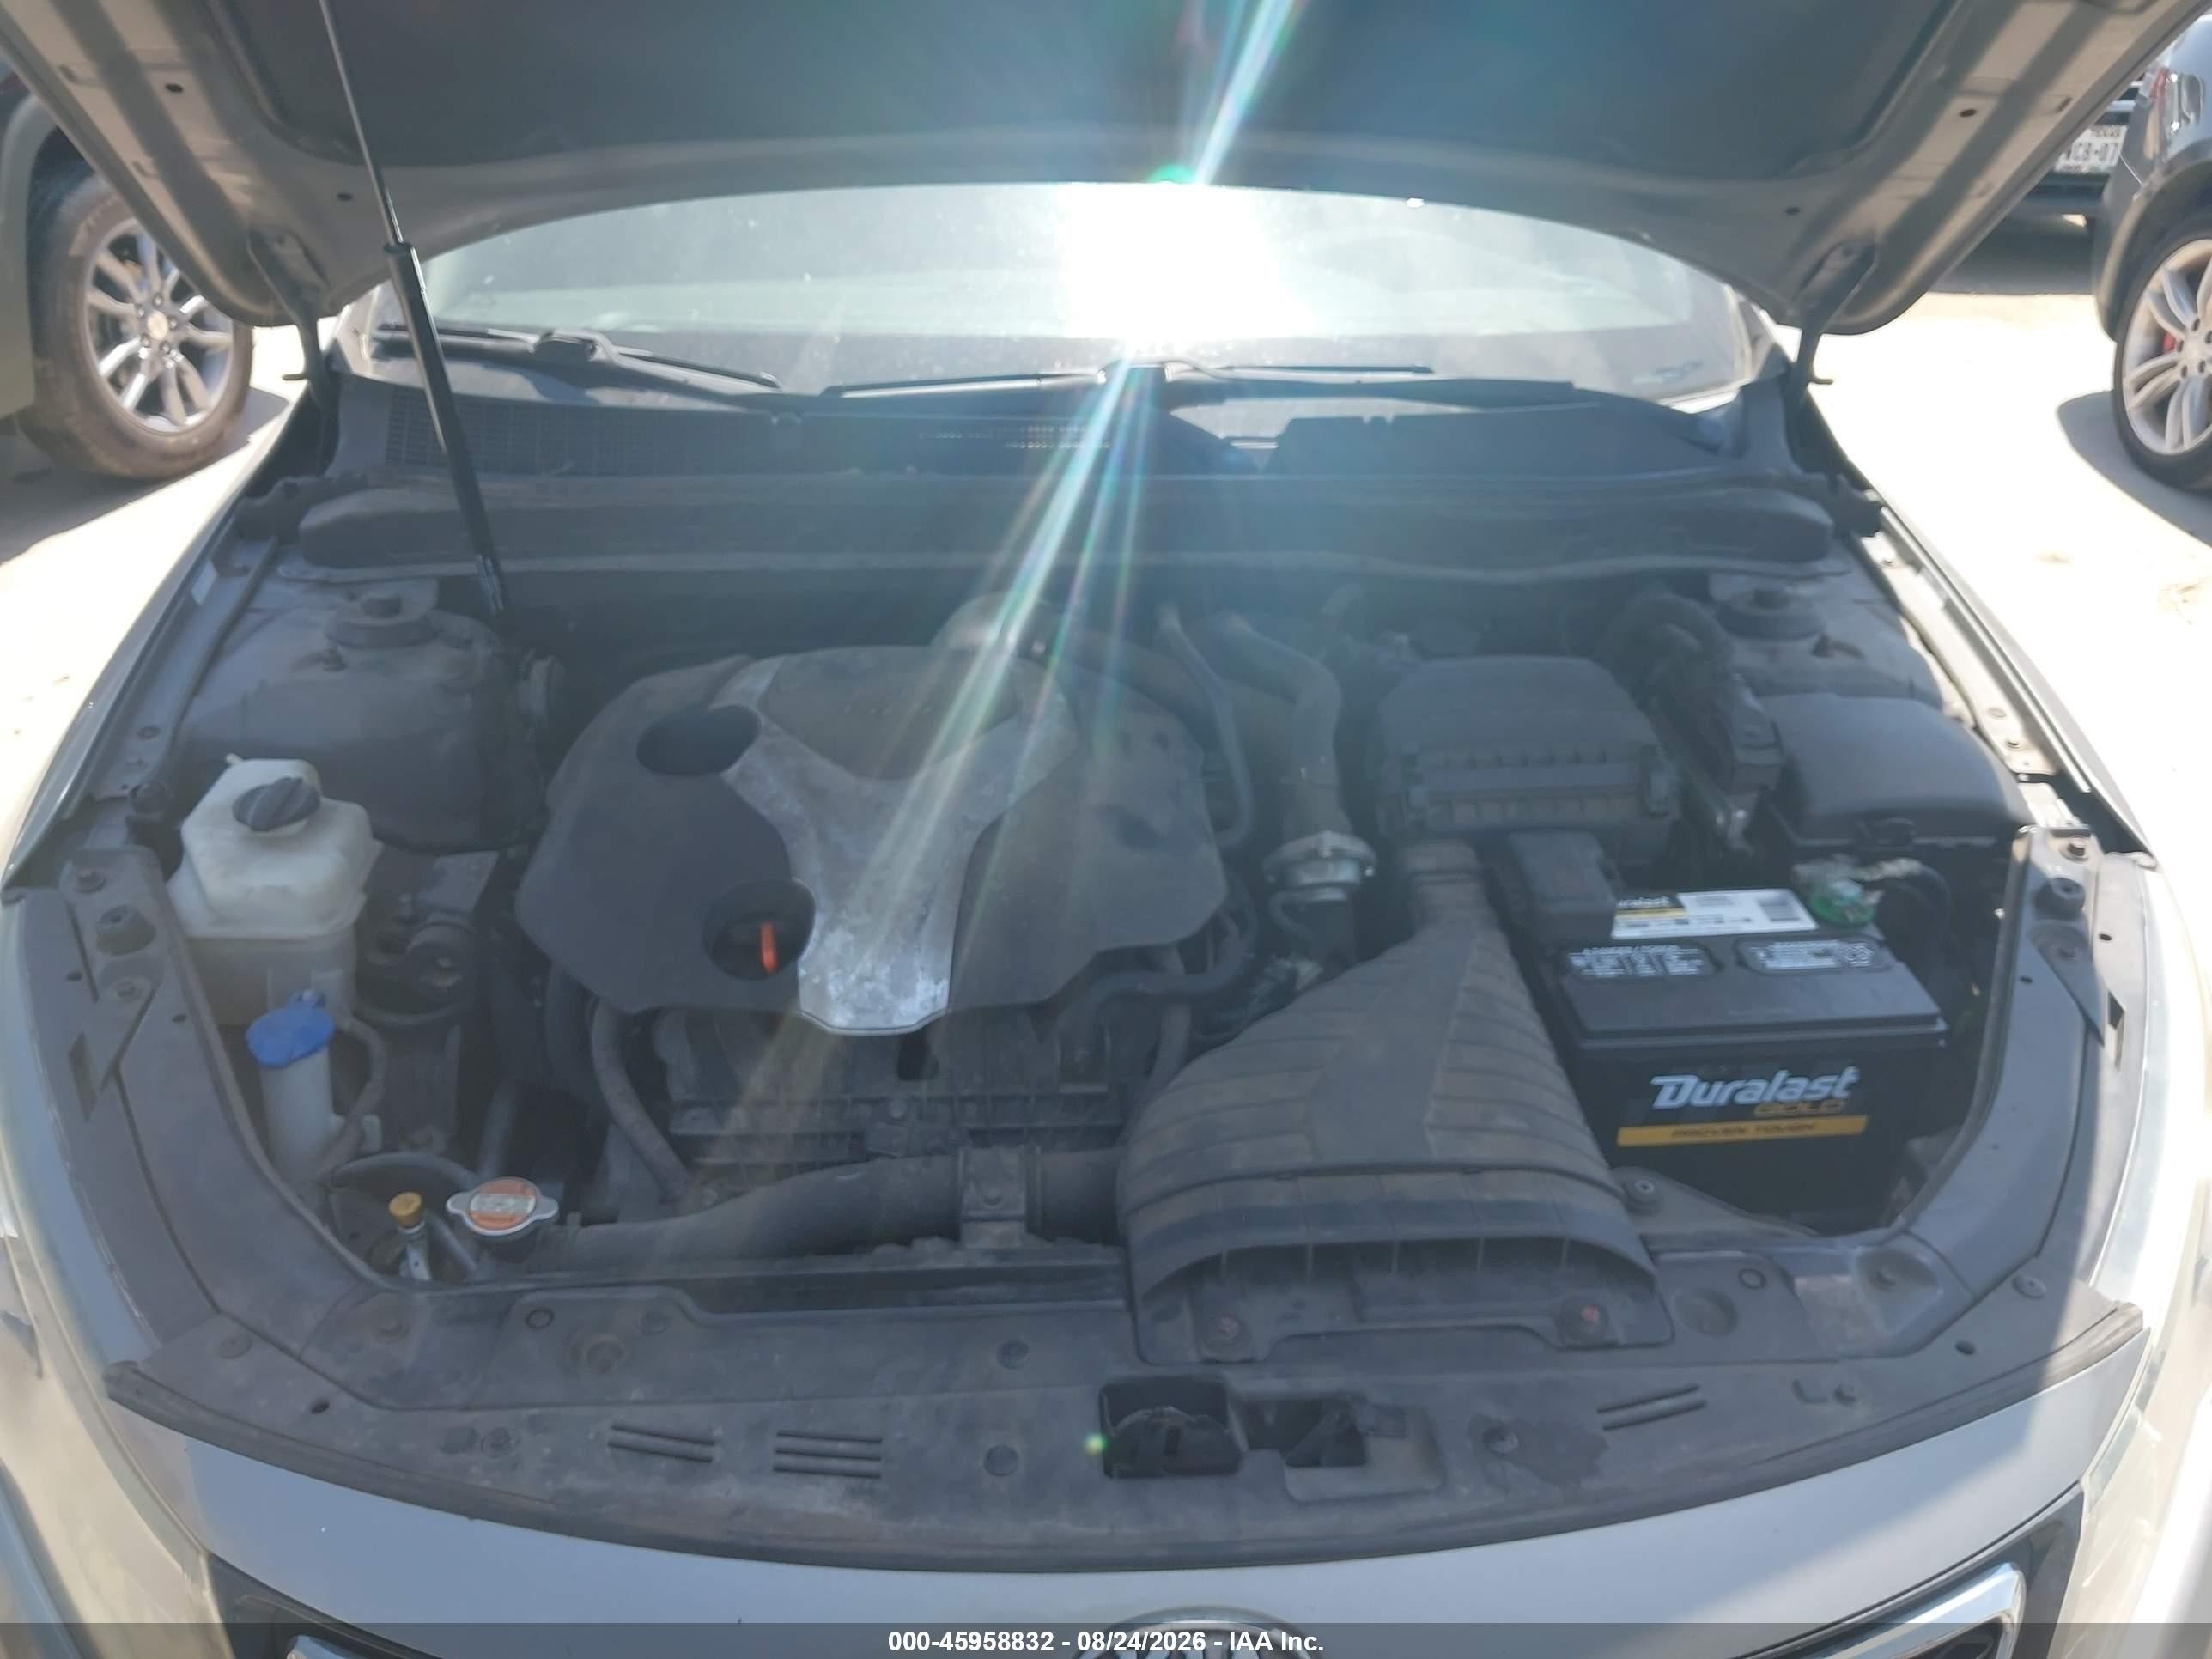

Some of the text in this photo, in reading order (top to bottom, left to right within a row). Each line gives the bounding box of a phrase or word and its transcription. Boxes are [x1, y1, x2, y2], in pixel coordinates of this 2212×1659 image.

[1616, 895, 1670, 908] uralast
[1650, 1066, 1859, 1109] Duralast
[1753, 1098, 1847, 1116] GOLD
